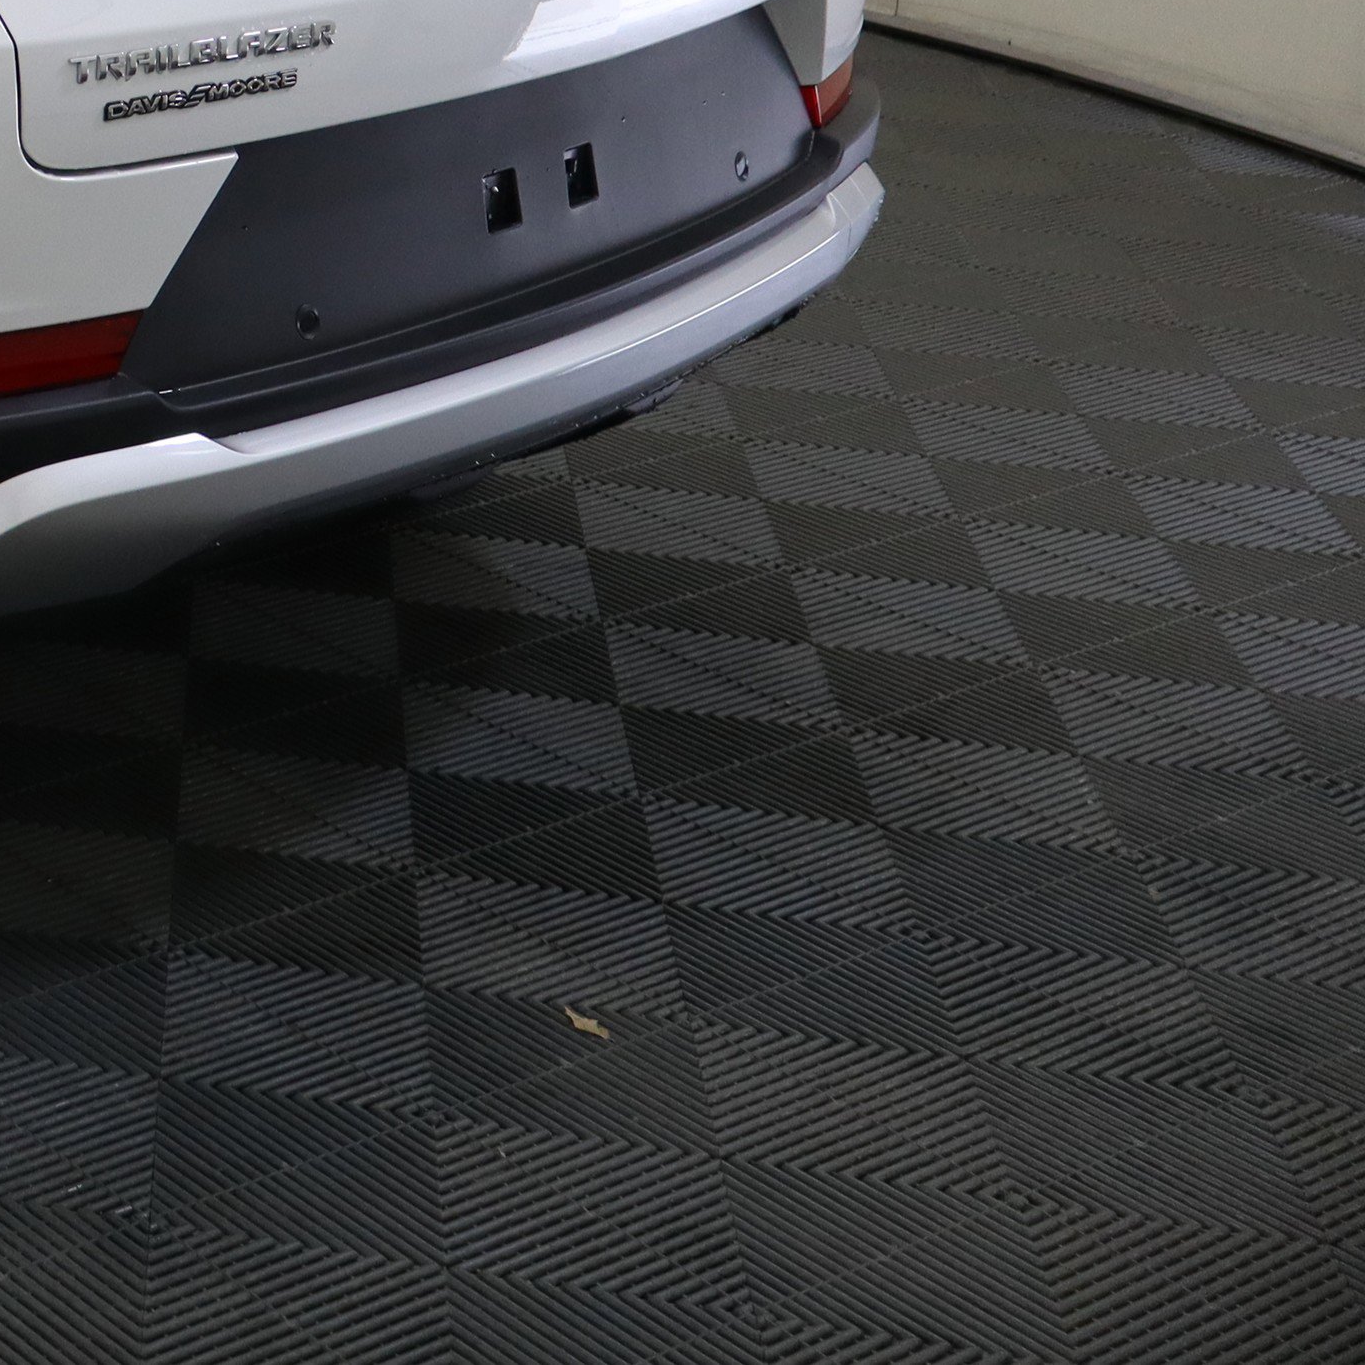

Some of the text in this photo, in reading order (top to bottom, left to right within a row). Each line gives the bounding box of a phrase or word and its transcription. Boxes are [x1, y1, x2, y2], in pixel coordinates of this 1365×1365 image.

[68, 21, 337, 84] TRAILBLAZER
[103, 67, 299, 122] DAVIS MOORE
